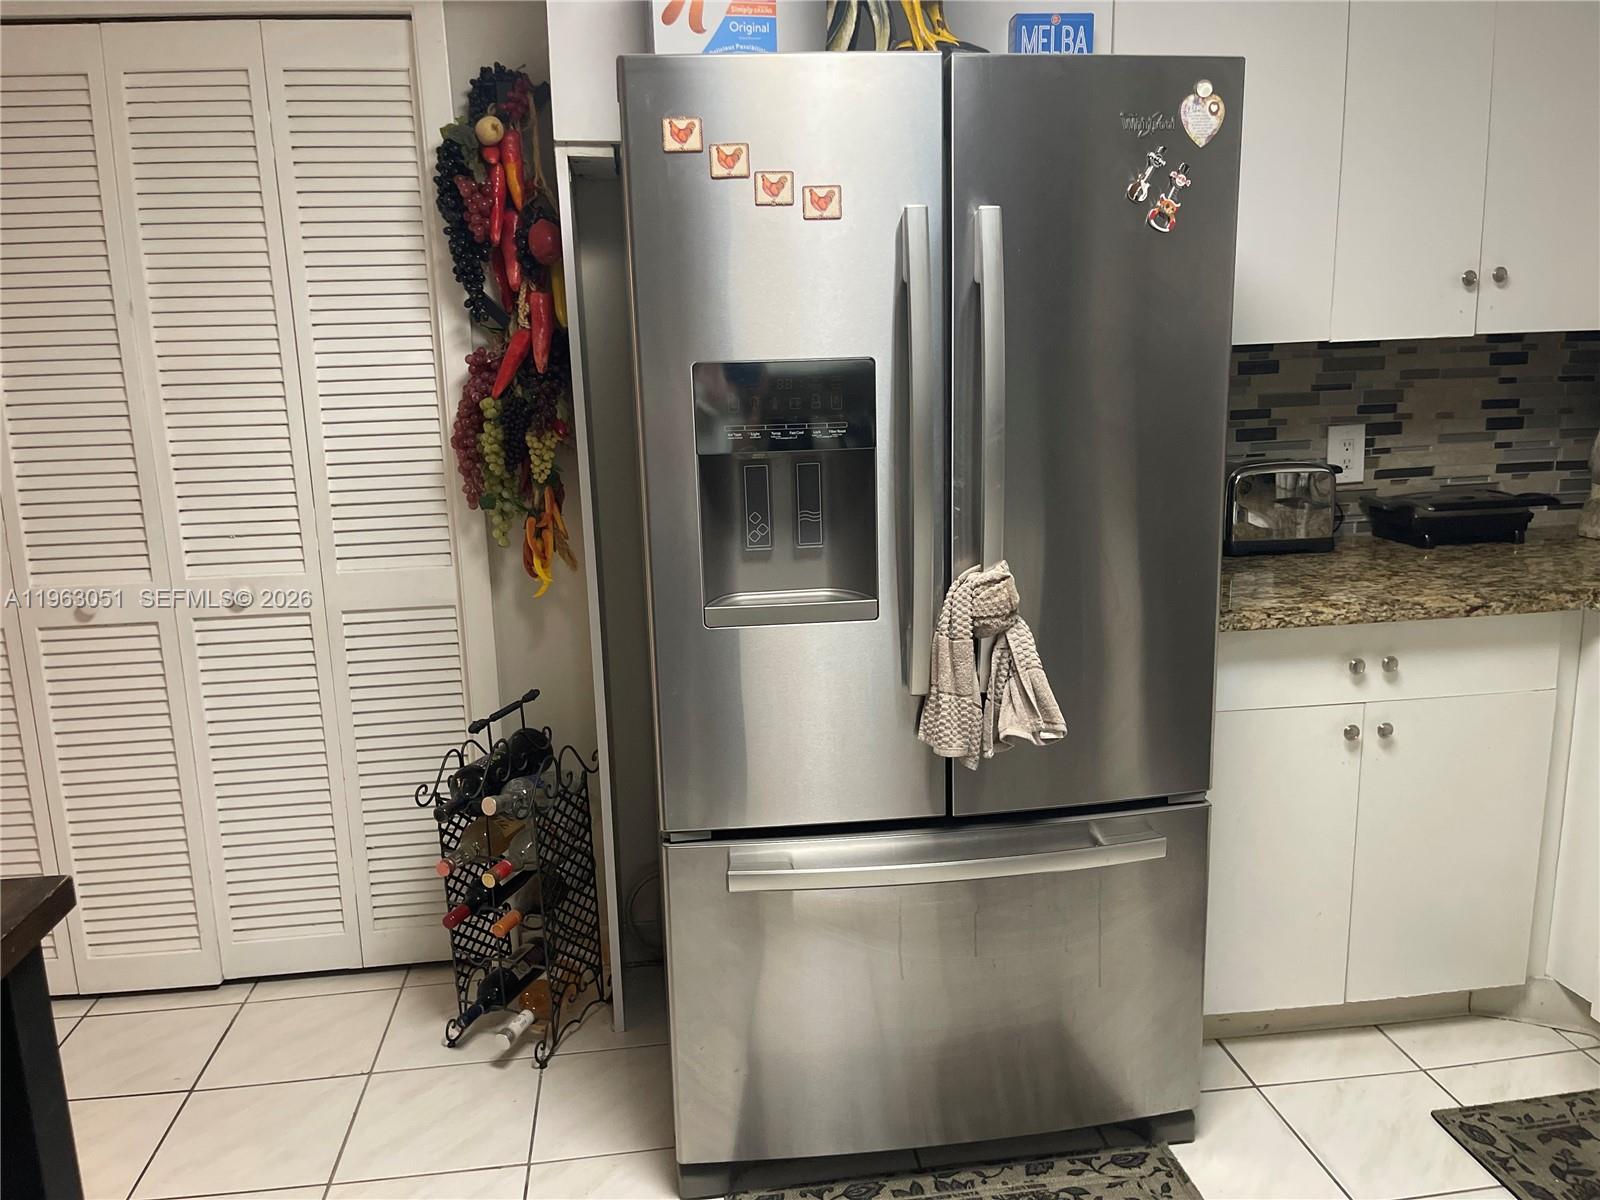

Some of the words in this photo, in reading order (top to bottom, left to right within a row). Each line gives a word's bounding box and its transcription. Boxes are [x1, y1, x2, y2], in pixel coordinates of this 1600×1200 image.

[729, 21, 769, 35] Original
[1021, 25, 1088, 55] MELBA
[1120, 112, 1176, 138] Whirlpool
